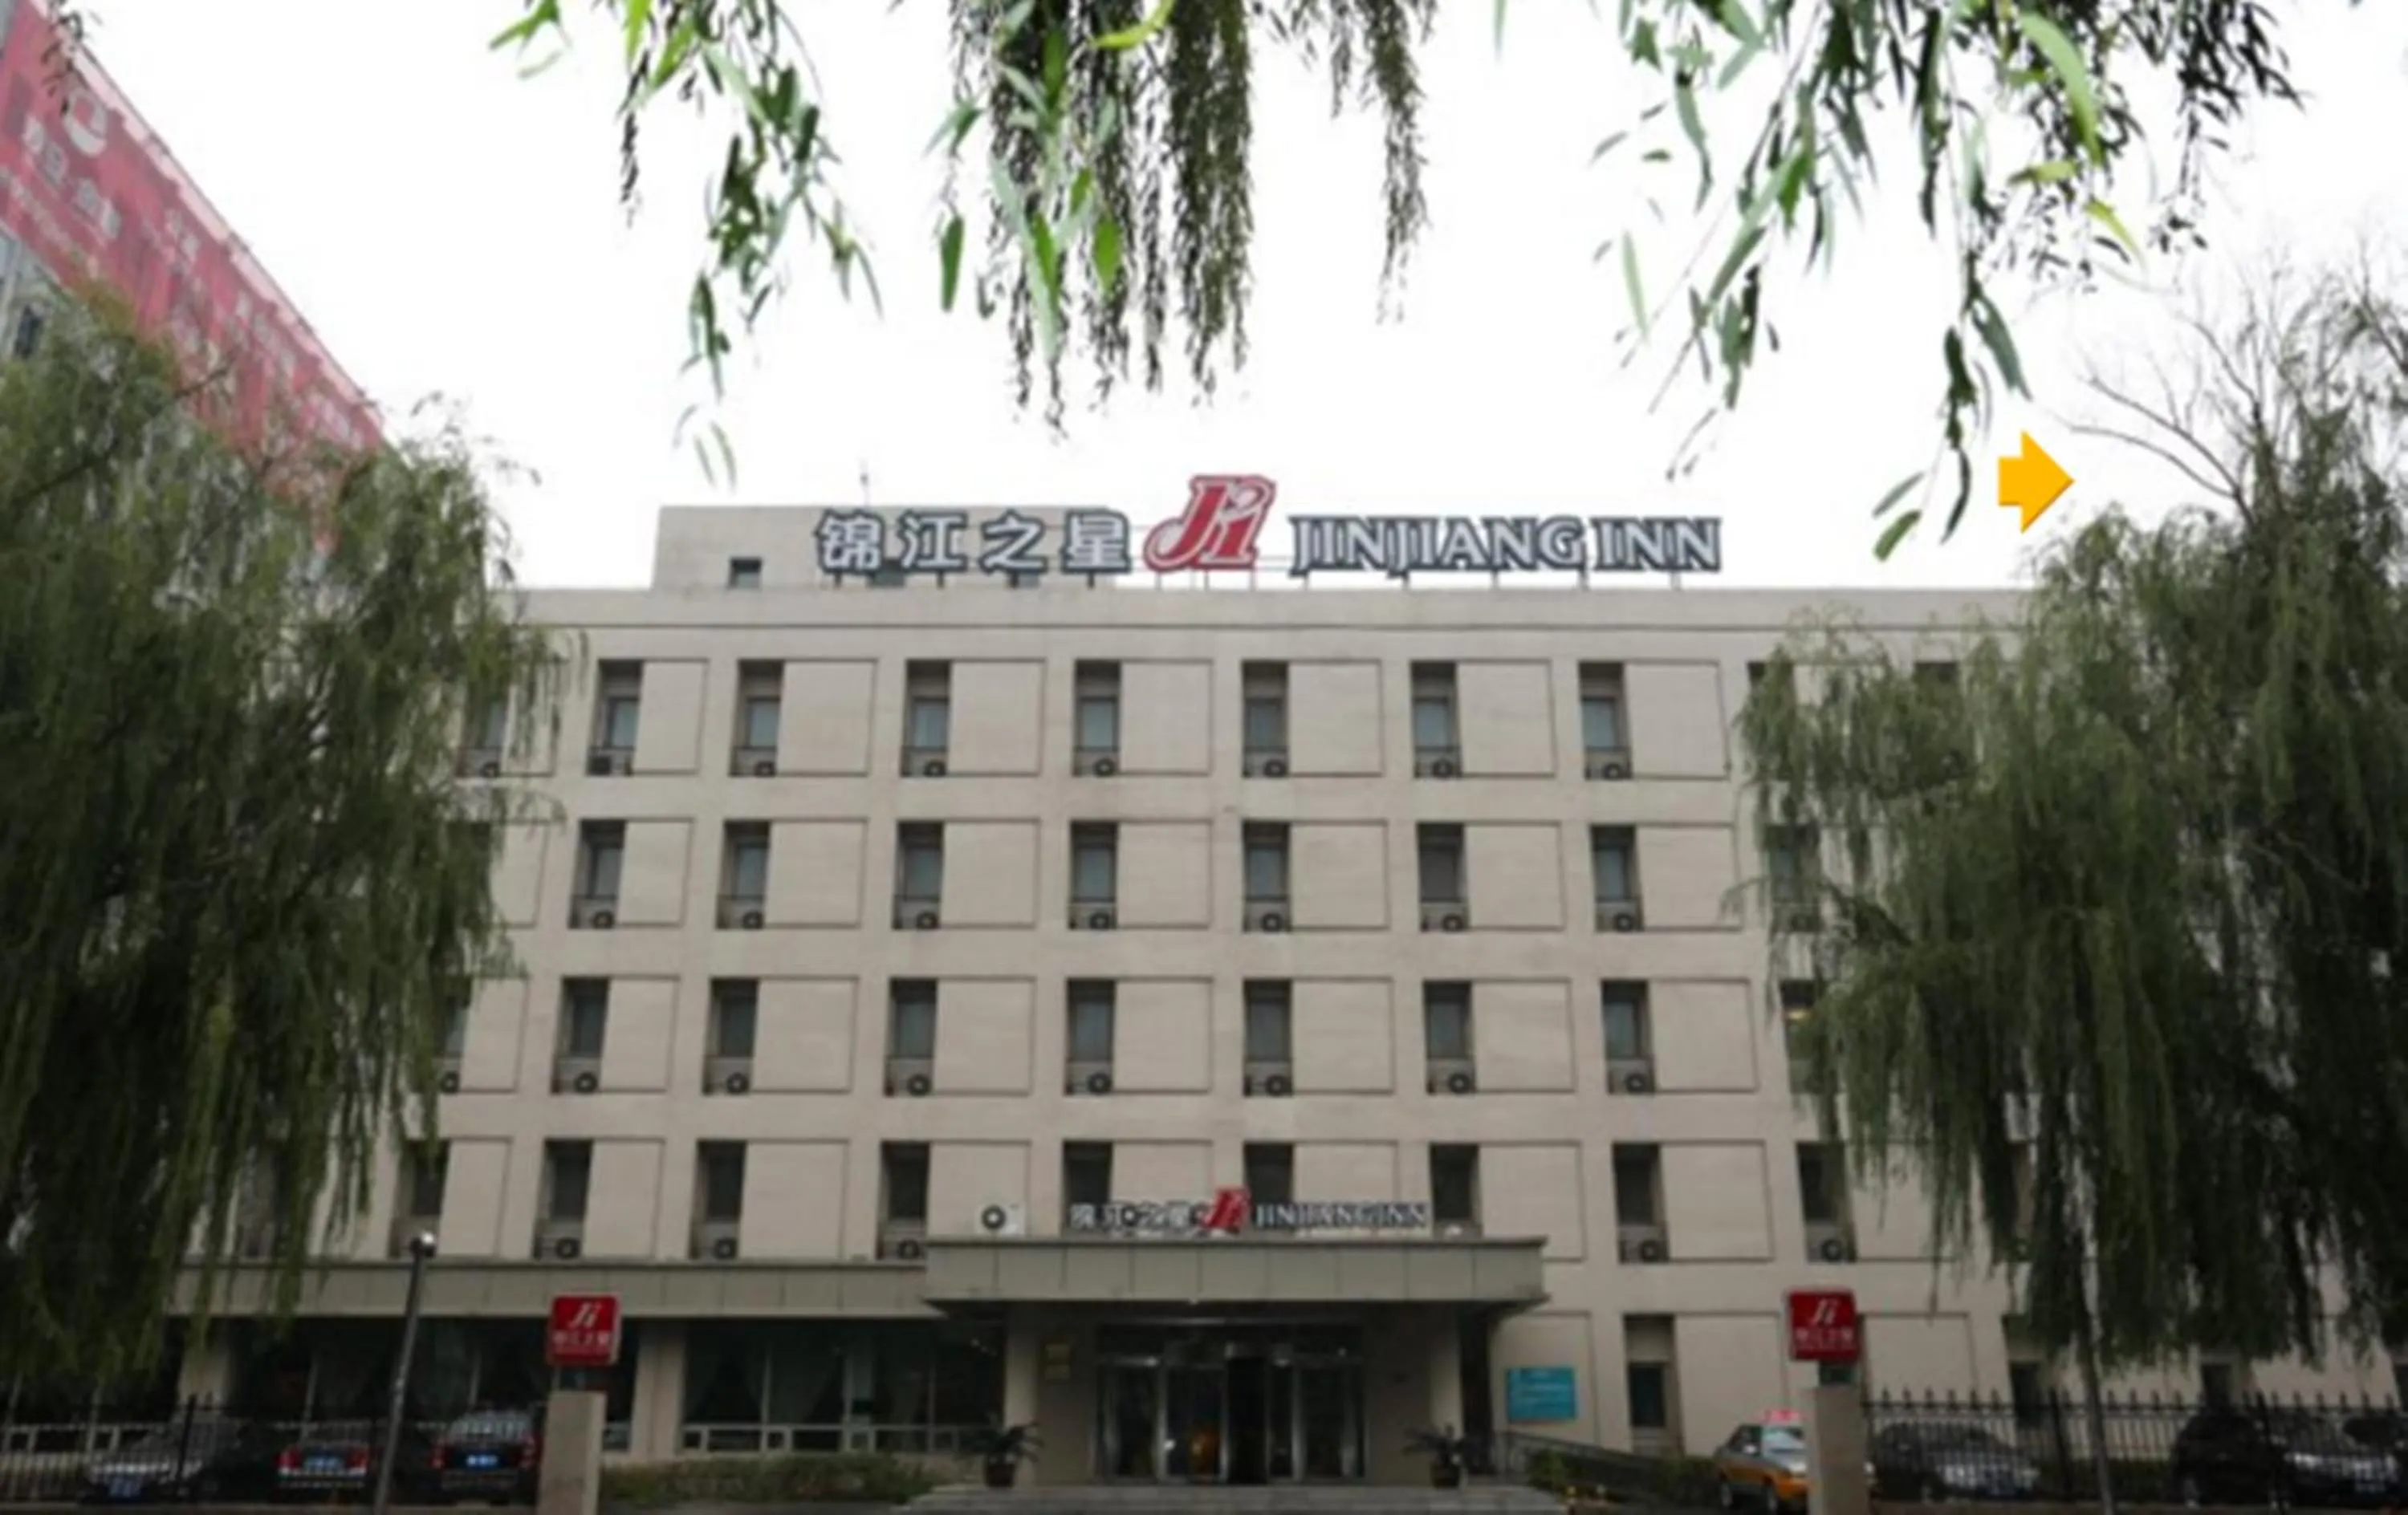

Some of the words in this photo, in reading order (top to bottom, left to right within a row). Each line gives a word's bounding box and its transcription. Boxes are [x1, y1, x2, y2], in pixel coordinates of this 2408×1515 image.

[816, 508, 1133, 575] 锦江之星
[1288, 516, 1586, 579] JINJIANG
[1589, 516, 1723, 573] INN
